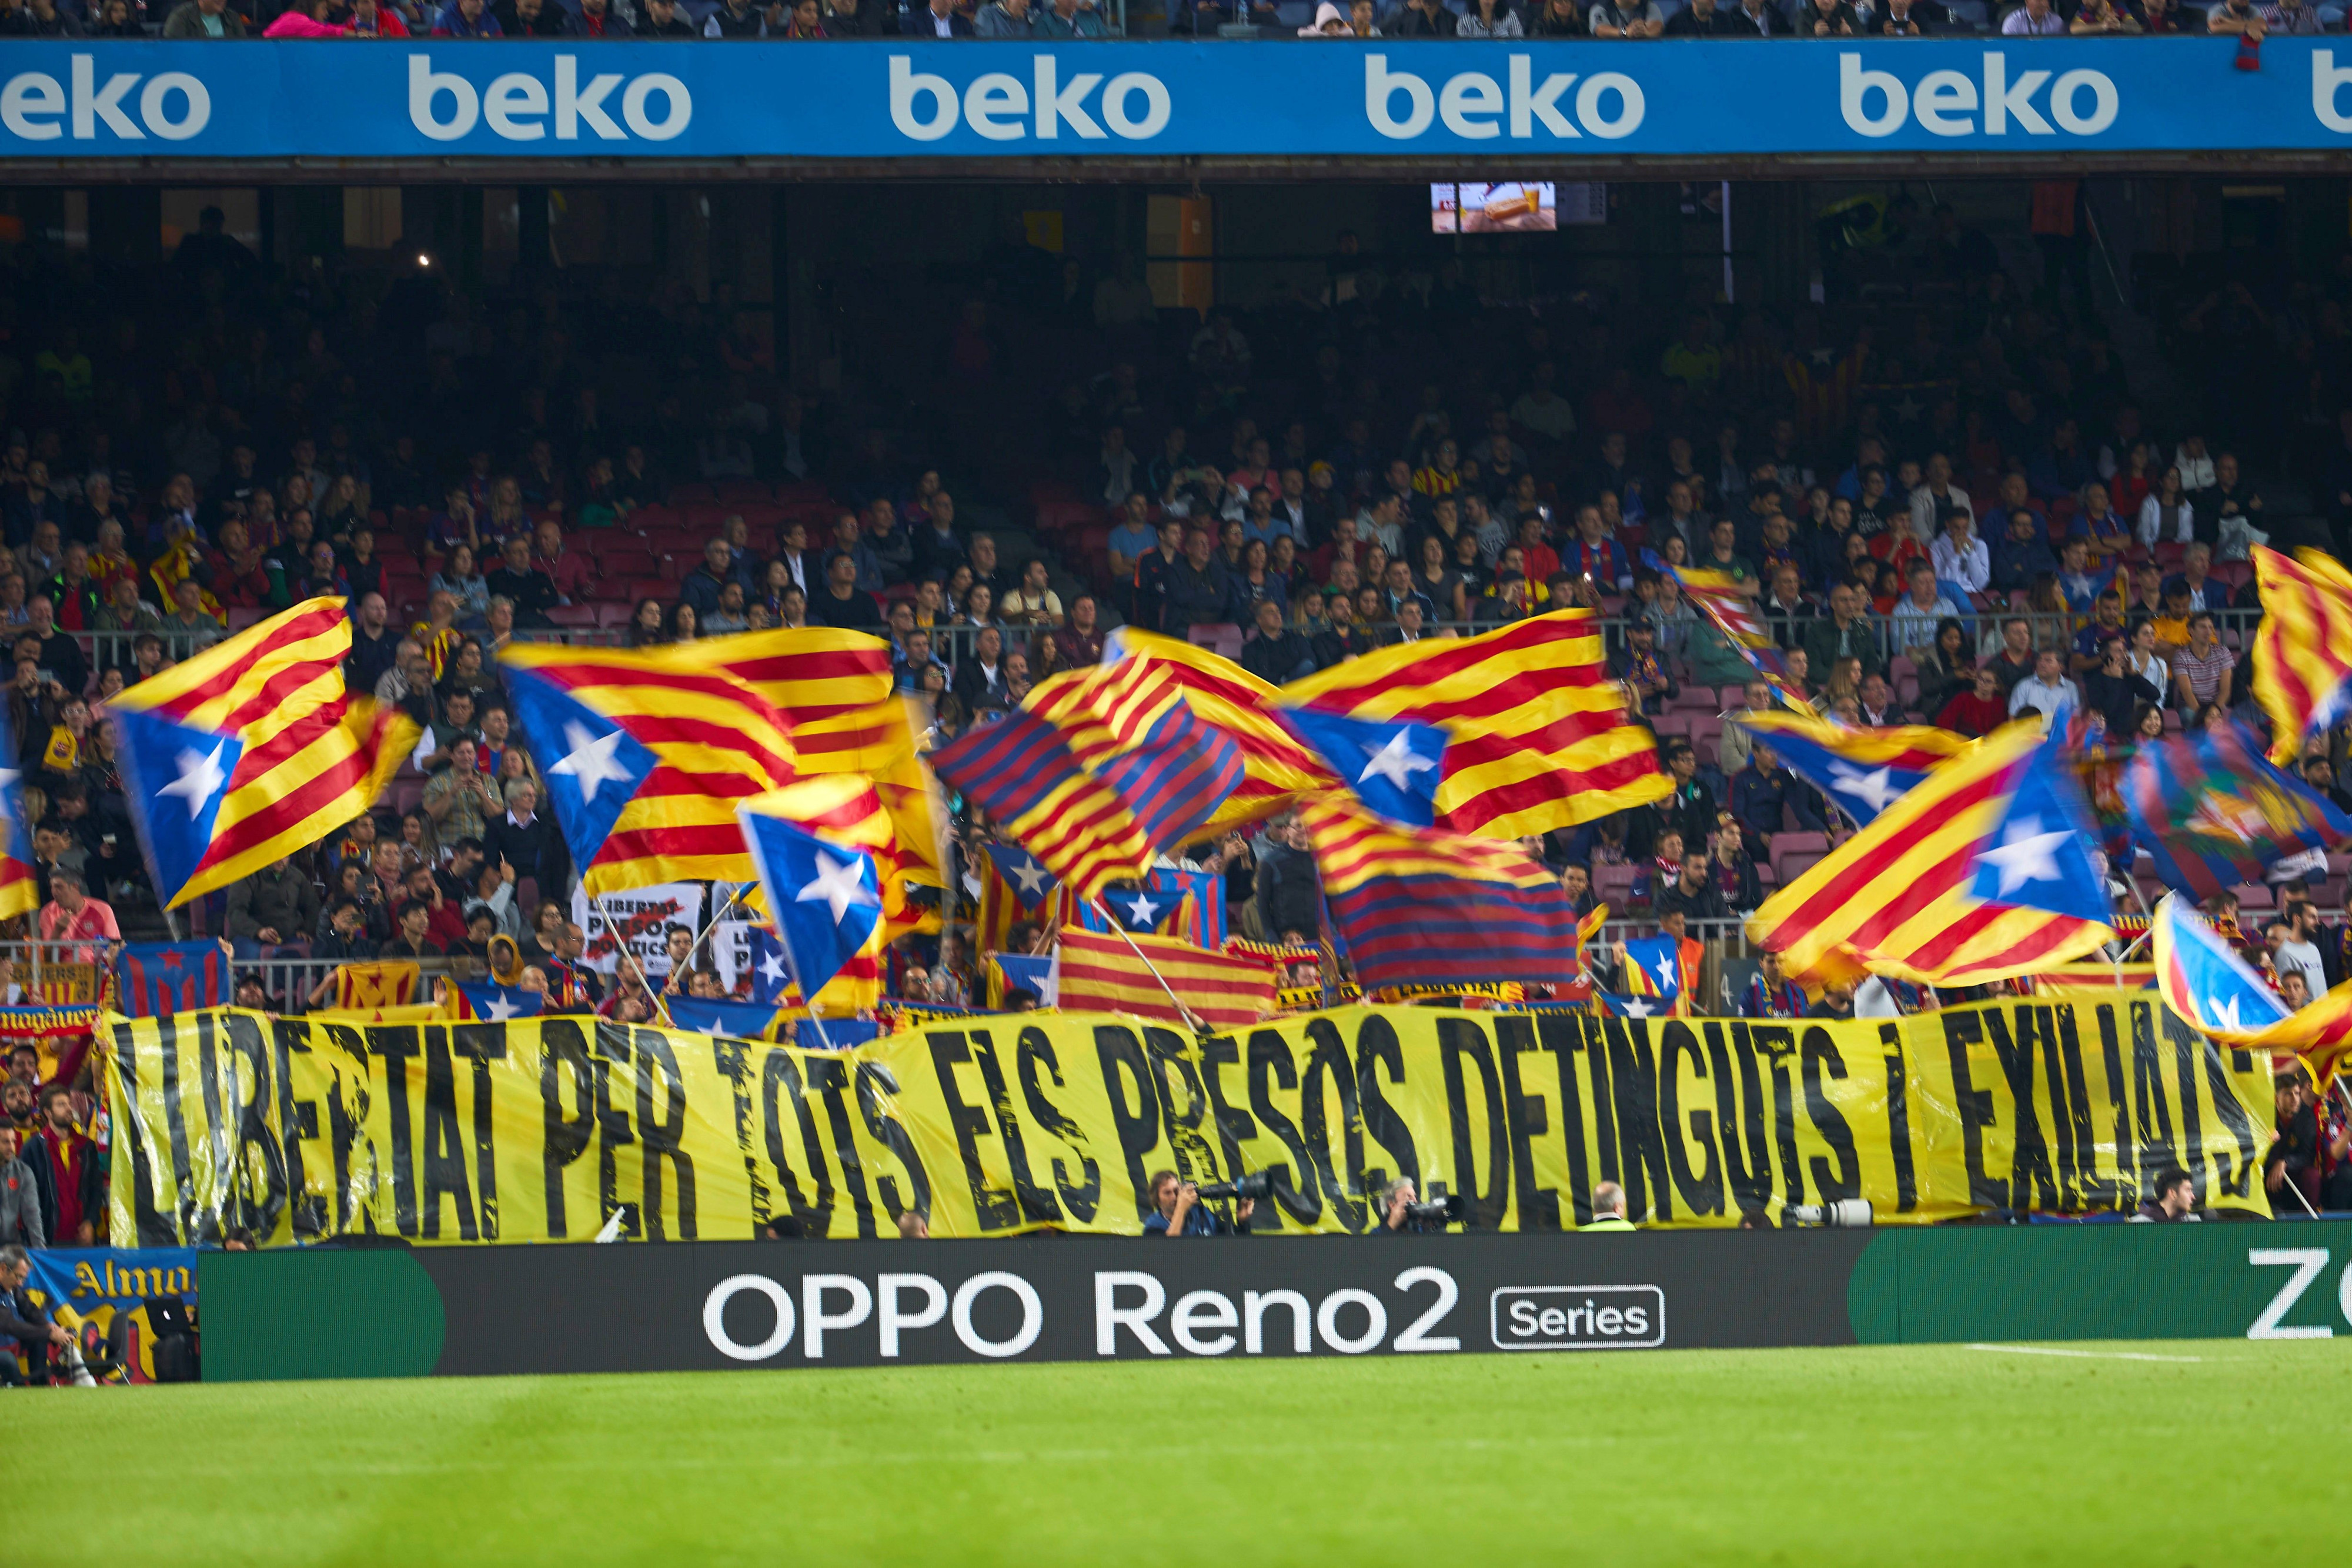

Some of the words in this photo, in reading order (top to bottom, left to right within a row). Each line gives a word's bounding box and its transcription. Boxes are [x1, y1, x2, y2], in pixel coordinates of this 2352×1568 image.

[408, 54, 692, 140] beko
[888, 55, 1171, 141] beko
[1365, 54, 1645, 139] beko
[1839, 52, 2119, 137] beko
[112, 1014, 507, 1246] LLIBERTAT
[540, 1019, 697, 1241] PER
[712, 1038, 931, 1239] TOTS
[925, 1025, 1101, 1231] ELS
[1093, 1012, 1421, 1235] PRESOS
[1435, 1016, 1861, 1232] DETINGUTS
[1942, 1001, 2256, 1215] EXILIATS
[71, 1258, 198, 1298] Almo
[703, 1271, 1043, 1361] OPPO
[1509, 1298, 1649, 1336] Series
[2247, 1246, 2352, 1340] Z
